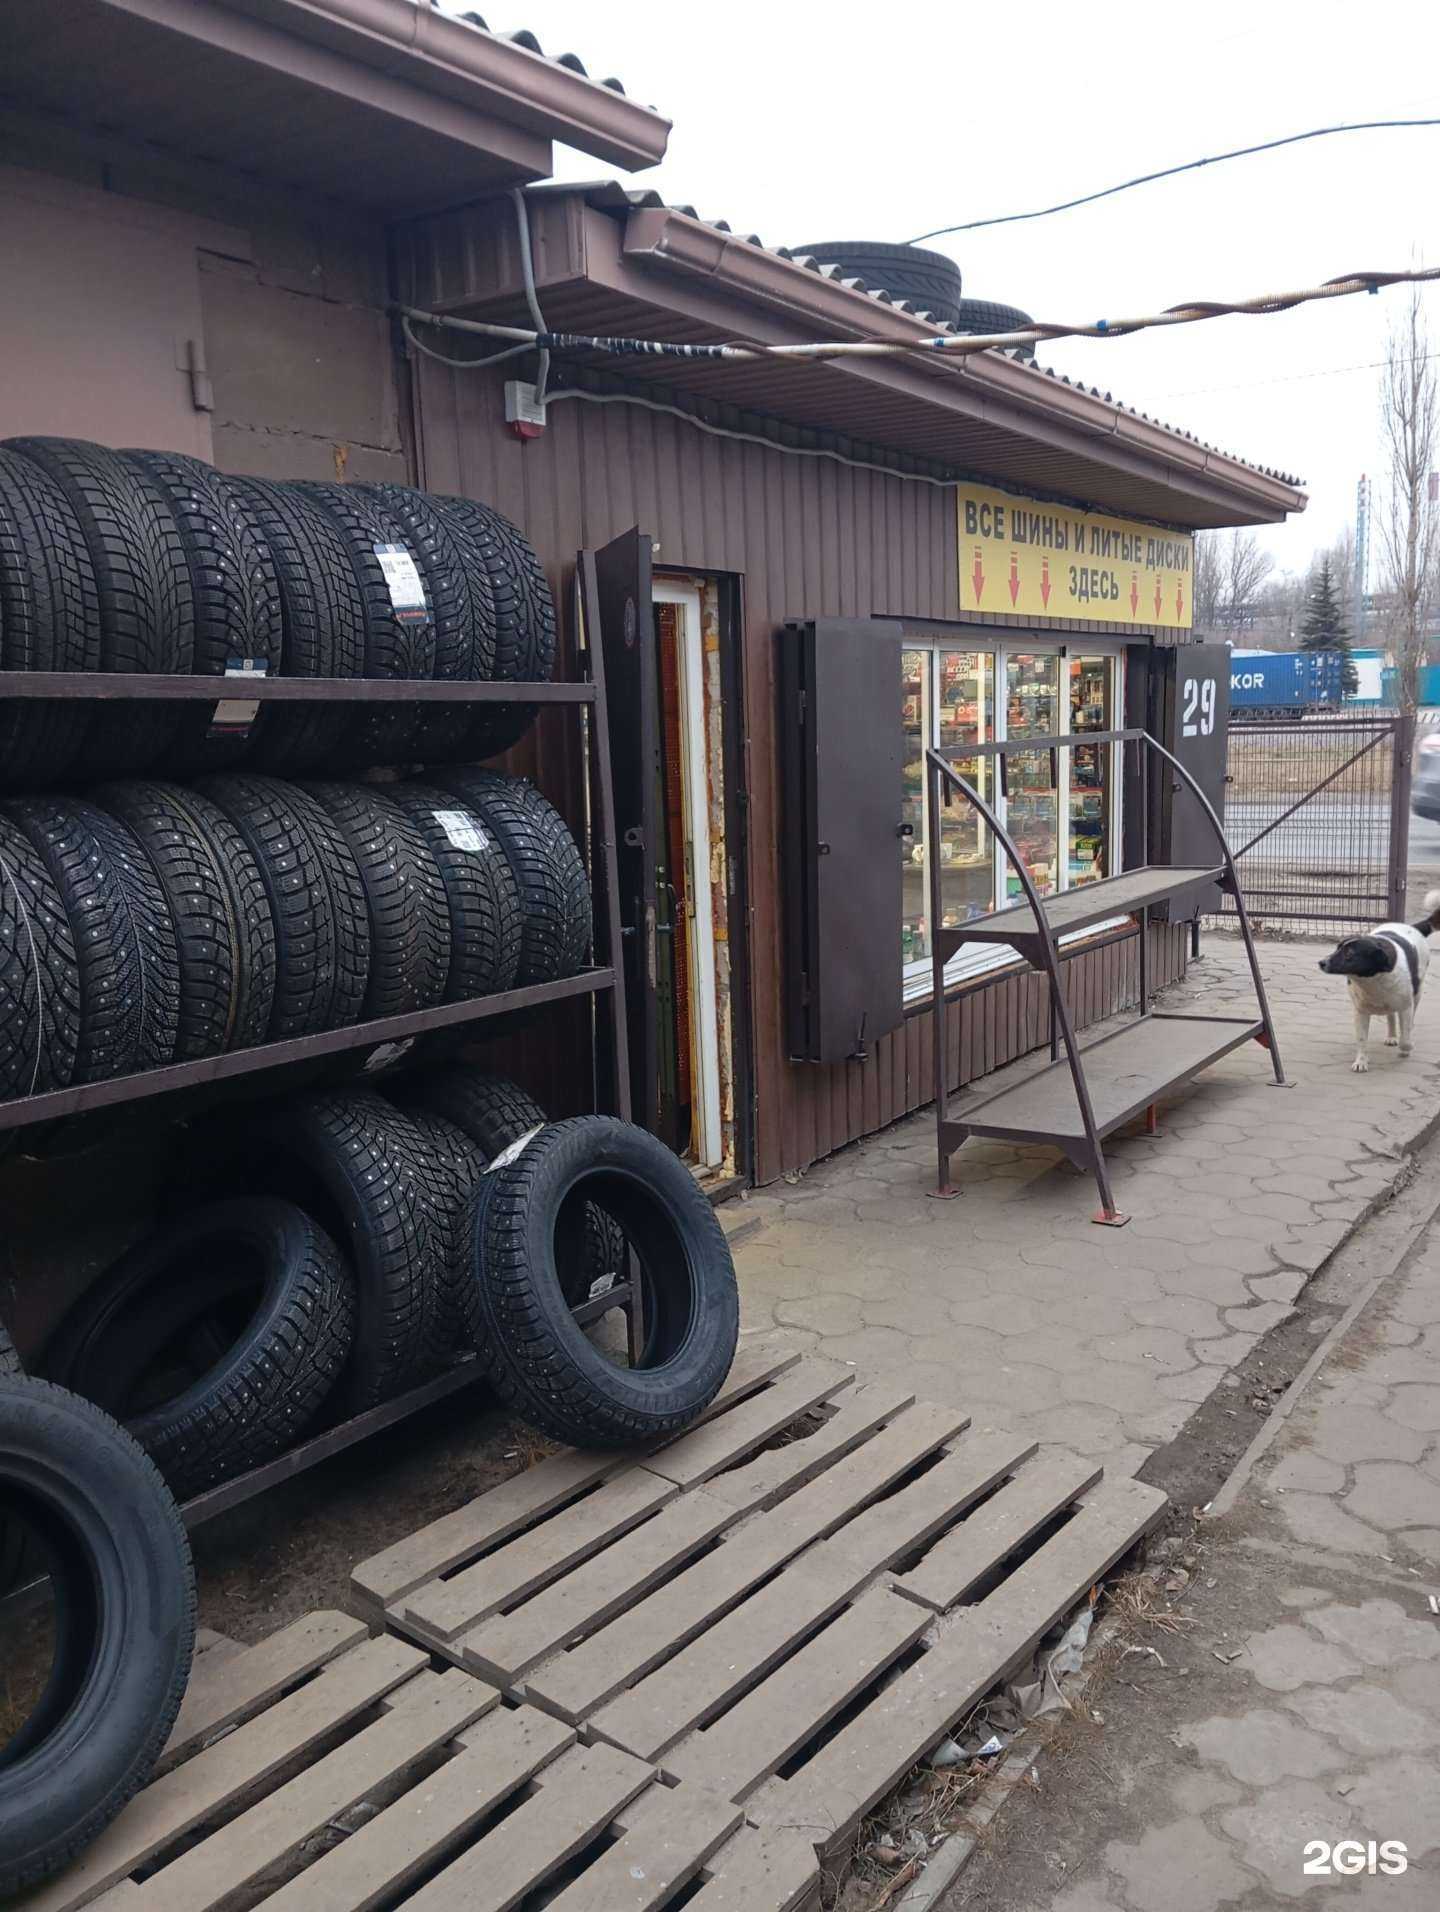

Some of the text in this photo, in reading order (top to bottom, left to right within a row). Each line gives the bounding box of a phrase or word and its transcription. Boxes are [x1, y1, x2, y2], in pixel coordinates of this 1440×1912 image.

[965, 500, 1189, 572] ВСЕ ШИНЫ И ЛИТЫЕ ДИСКИ
[1068, 565, 1120, 604] ЗДЕСЬ
[1230, 672, 1265, 689] KOR
[1182, 678, 1217, 738] 29
